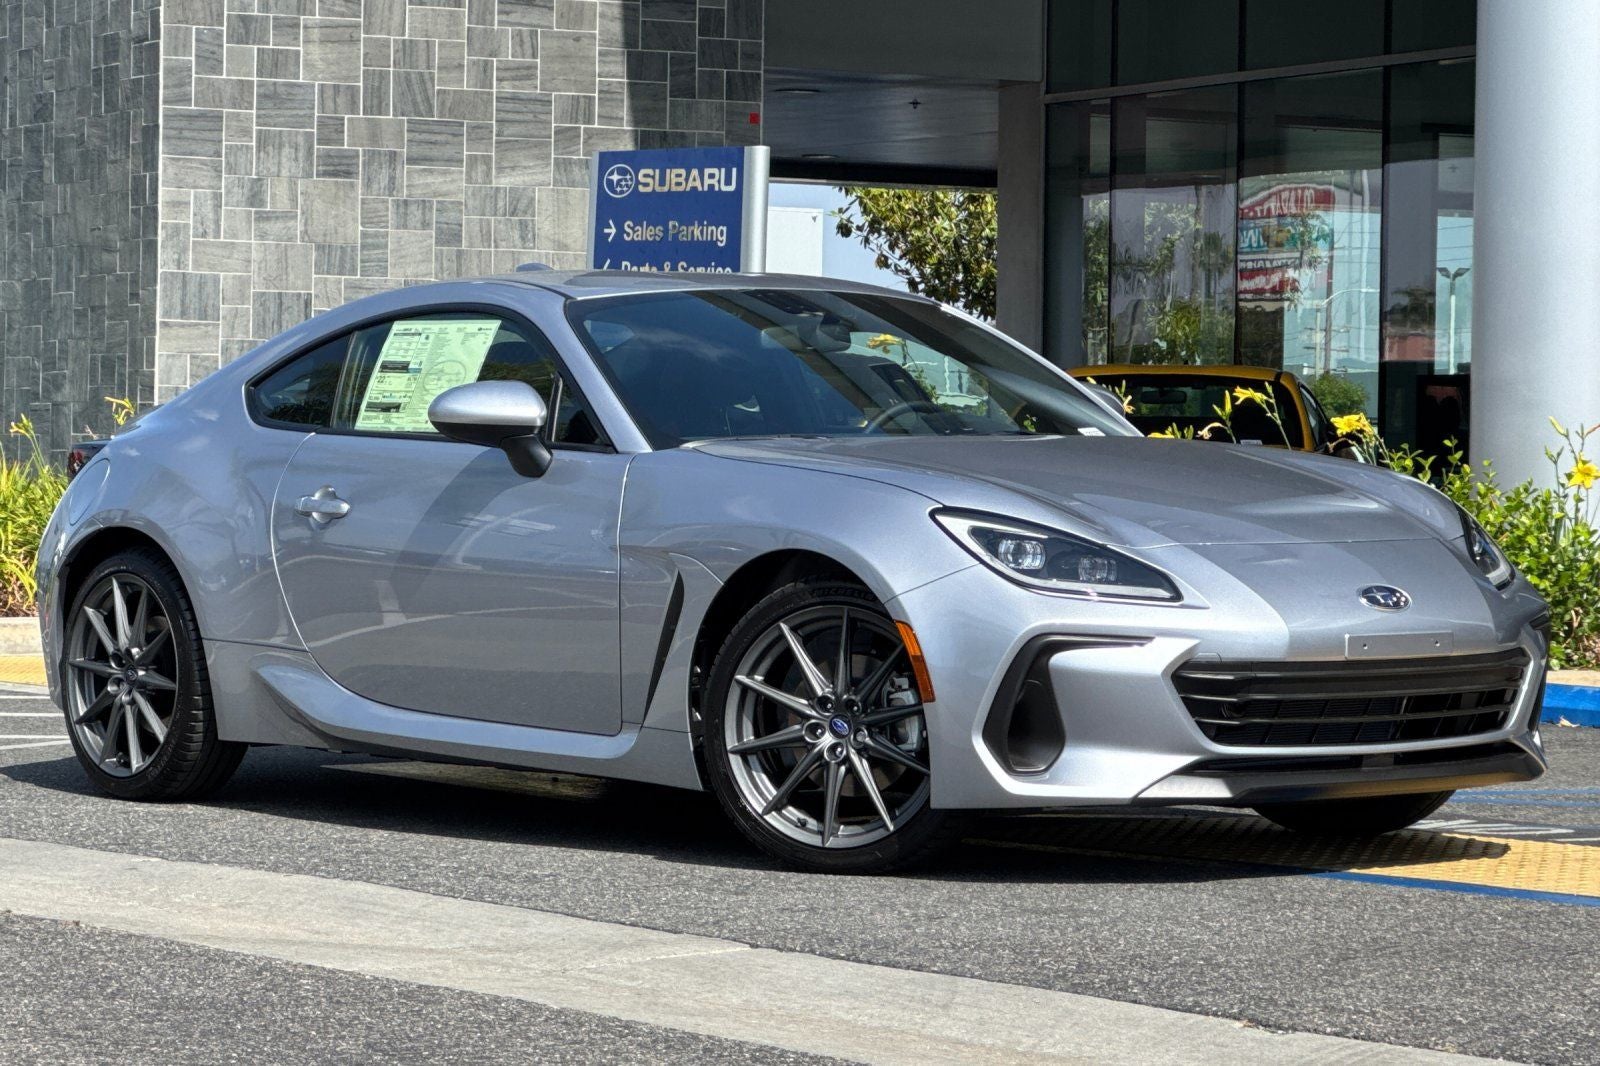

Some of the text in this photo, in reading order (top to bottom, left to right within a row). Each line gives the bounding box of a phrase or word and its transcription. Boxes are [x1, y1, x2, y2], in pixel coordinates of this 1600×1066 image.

[638, 167, 737, 192] SUBARU
[623, 220, 727, 247] Sales Parking
